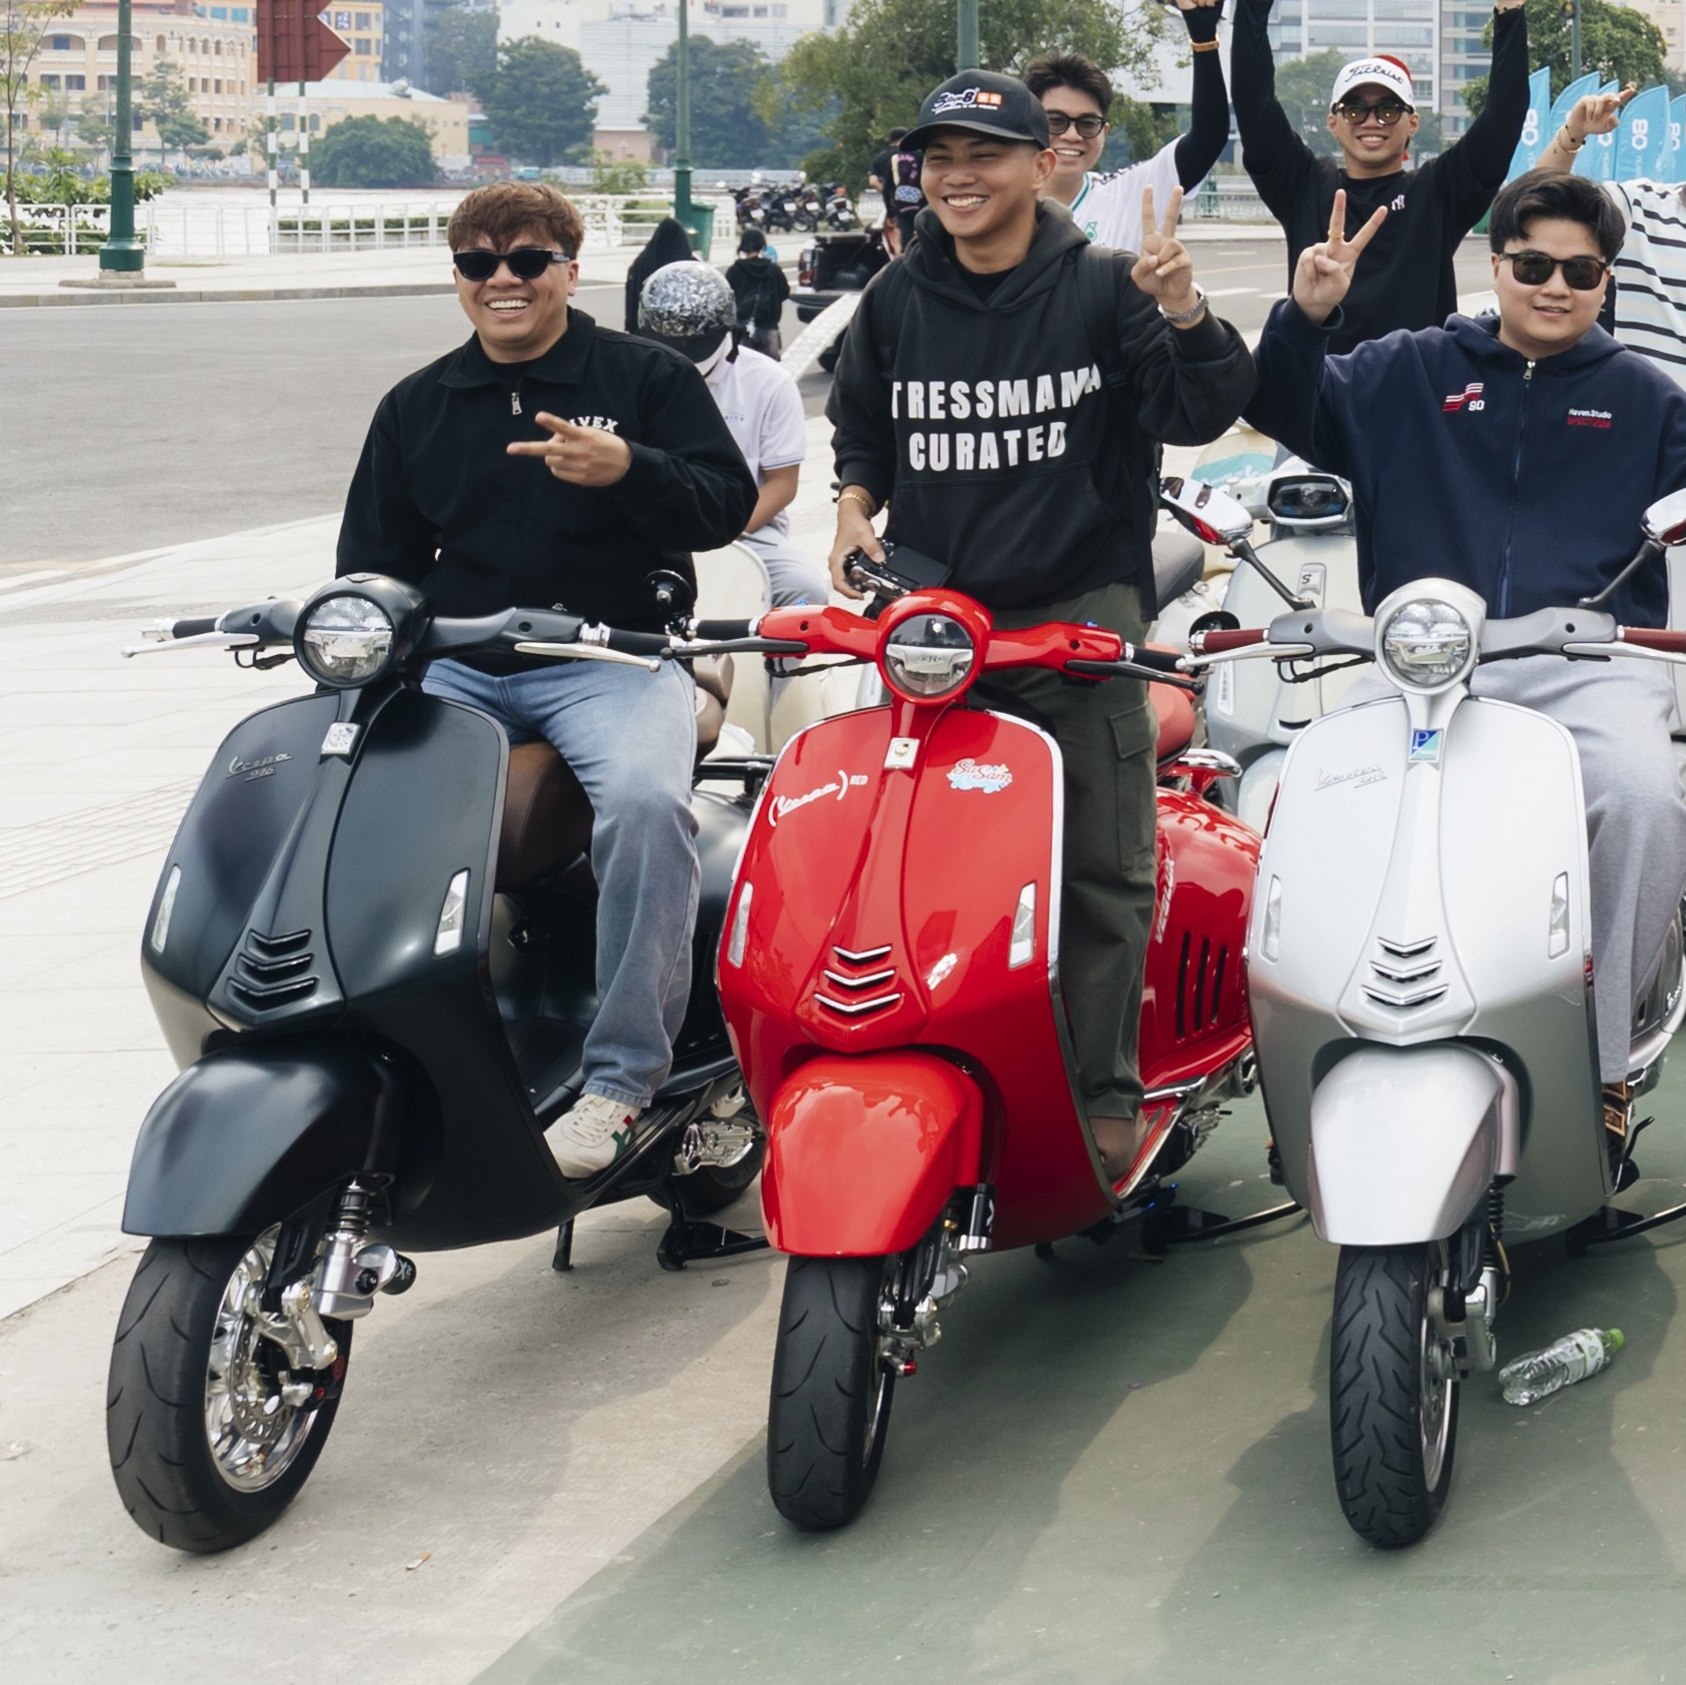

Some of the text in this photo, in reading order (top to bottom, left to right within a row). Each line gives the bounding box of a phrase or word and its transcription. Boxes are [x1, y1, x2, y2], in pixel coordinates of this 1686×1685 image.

[1631, 118, 1648, 151] 80
[909, 421, 1067, 471] CURATED
[225, 753, 294, 780] Vespa
